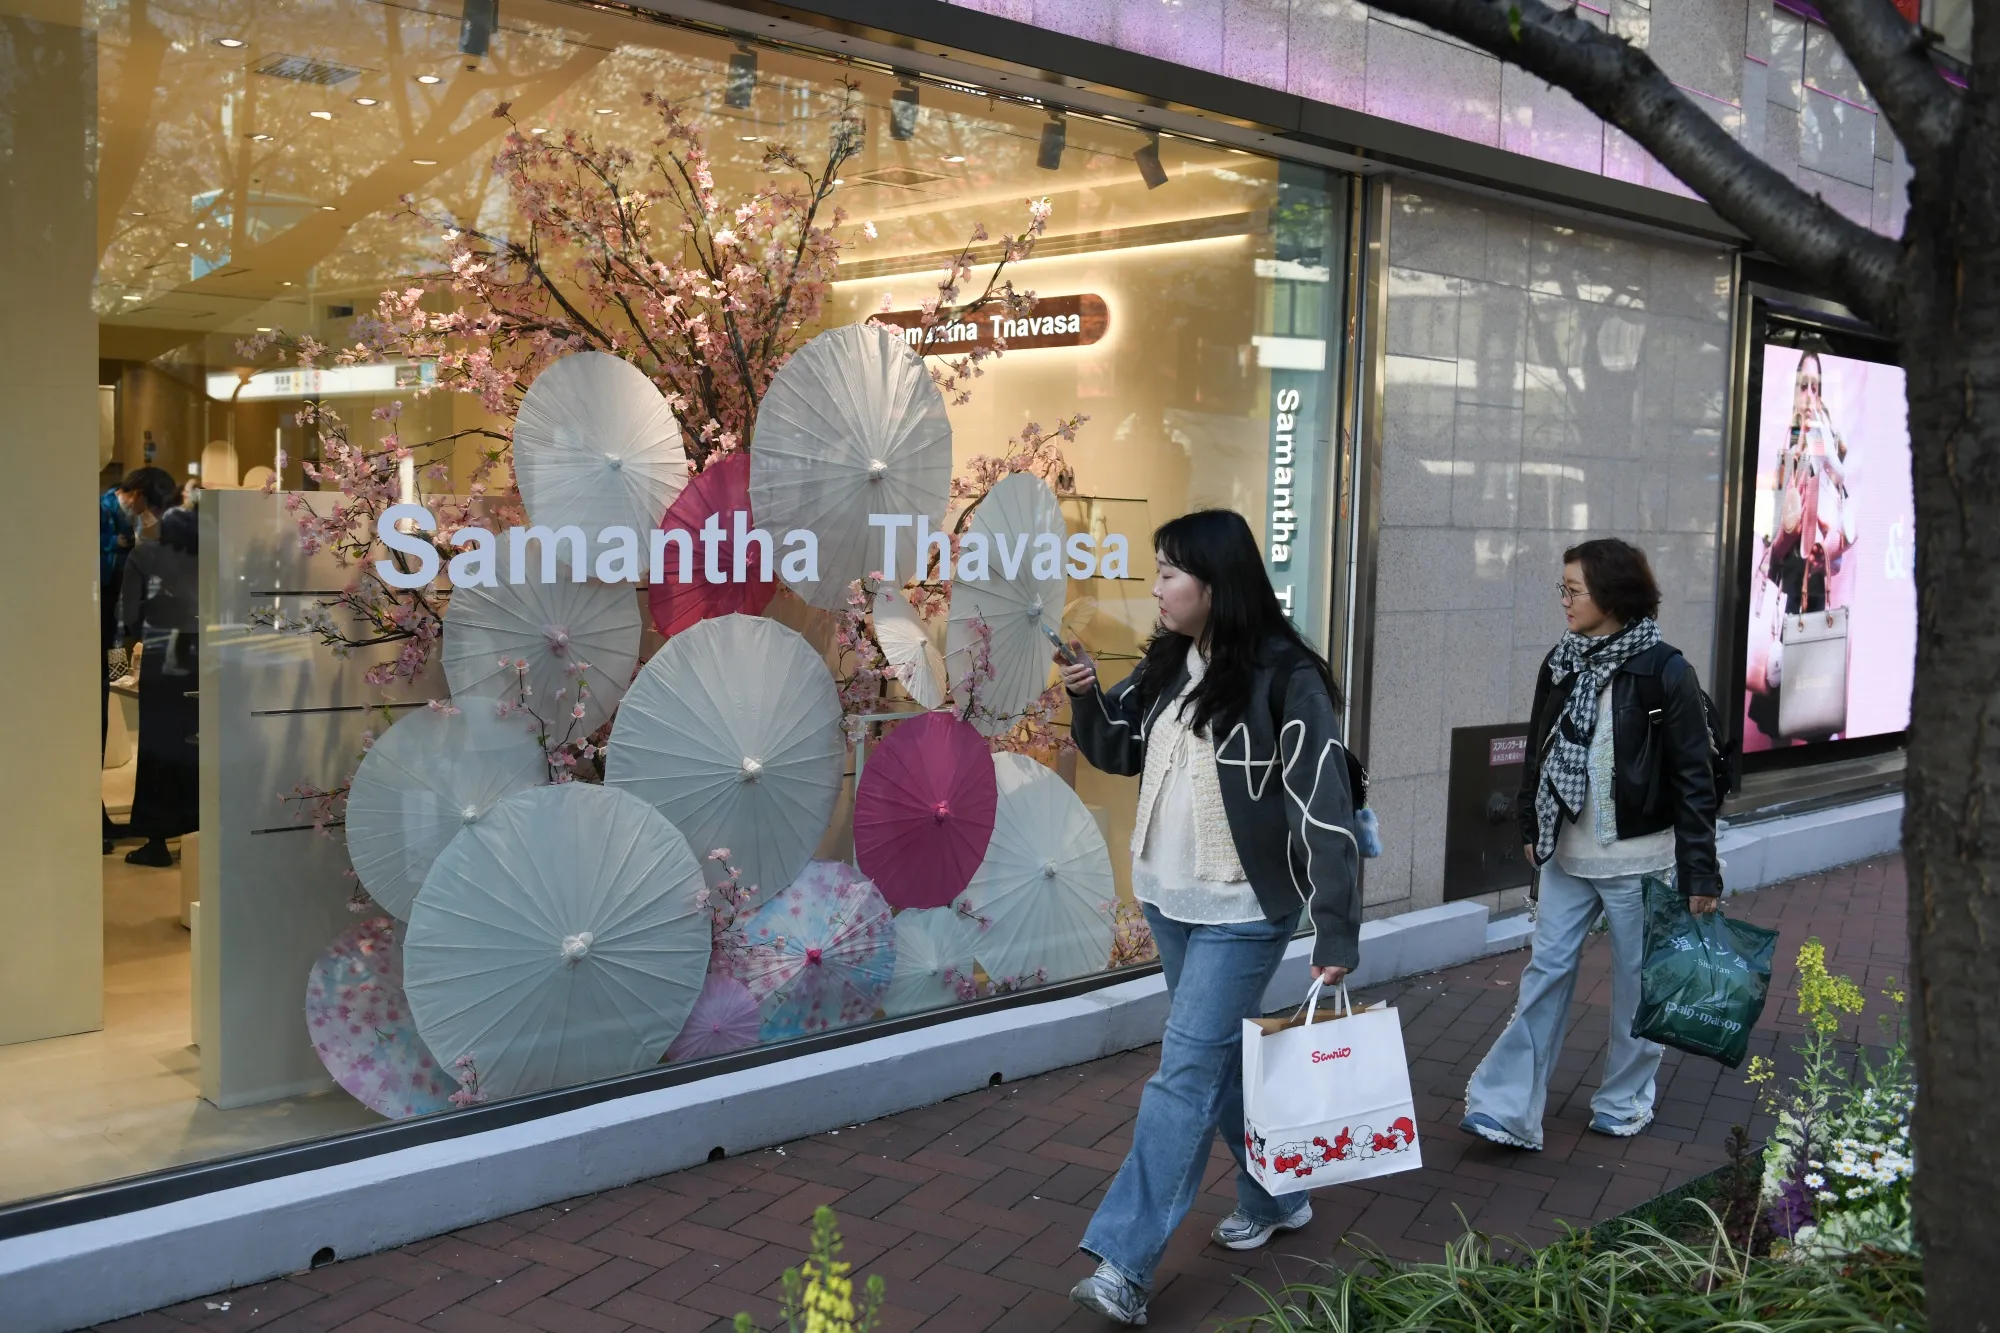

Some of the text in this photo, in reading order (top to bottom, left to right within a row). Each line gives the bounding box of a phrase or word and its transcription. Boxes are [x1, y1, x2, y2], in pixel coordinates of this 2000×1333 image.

[898, 319, 978, 345] mantha
[1271, 388, 1299, 563] Samantha
[375, 503, 1129, 589] Samantha Thavasa
[1311, 1047, 1352, 1064] Sanrio
